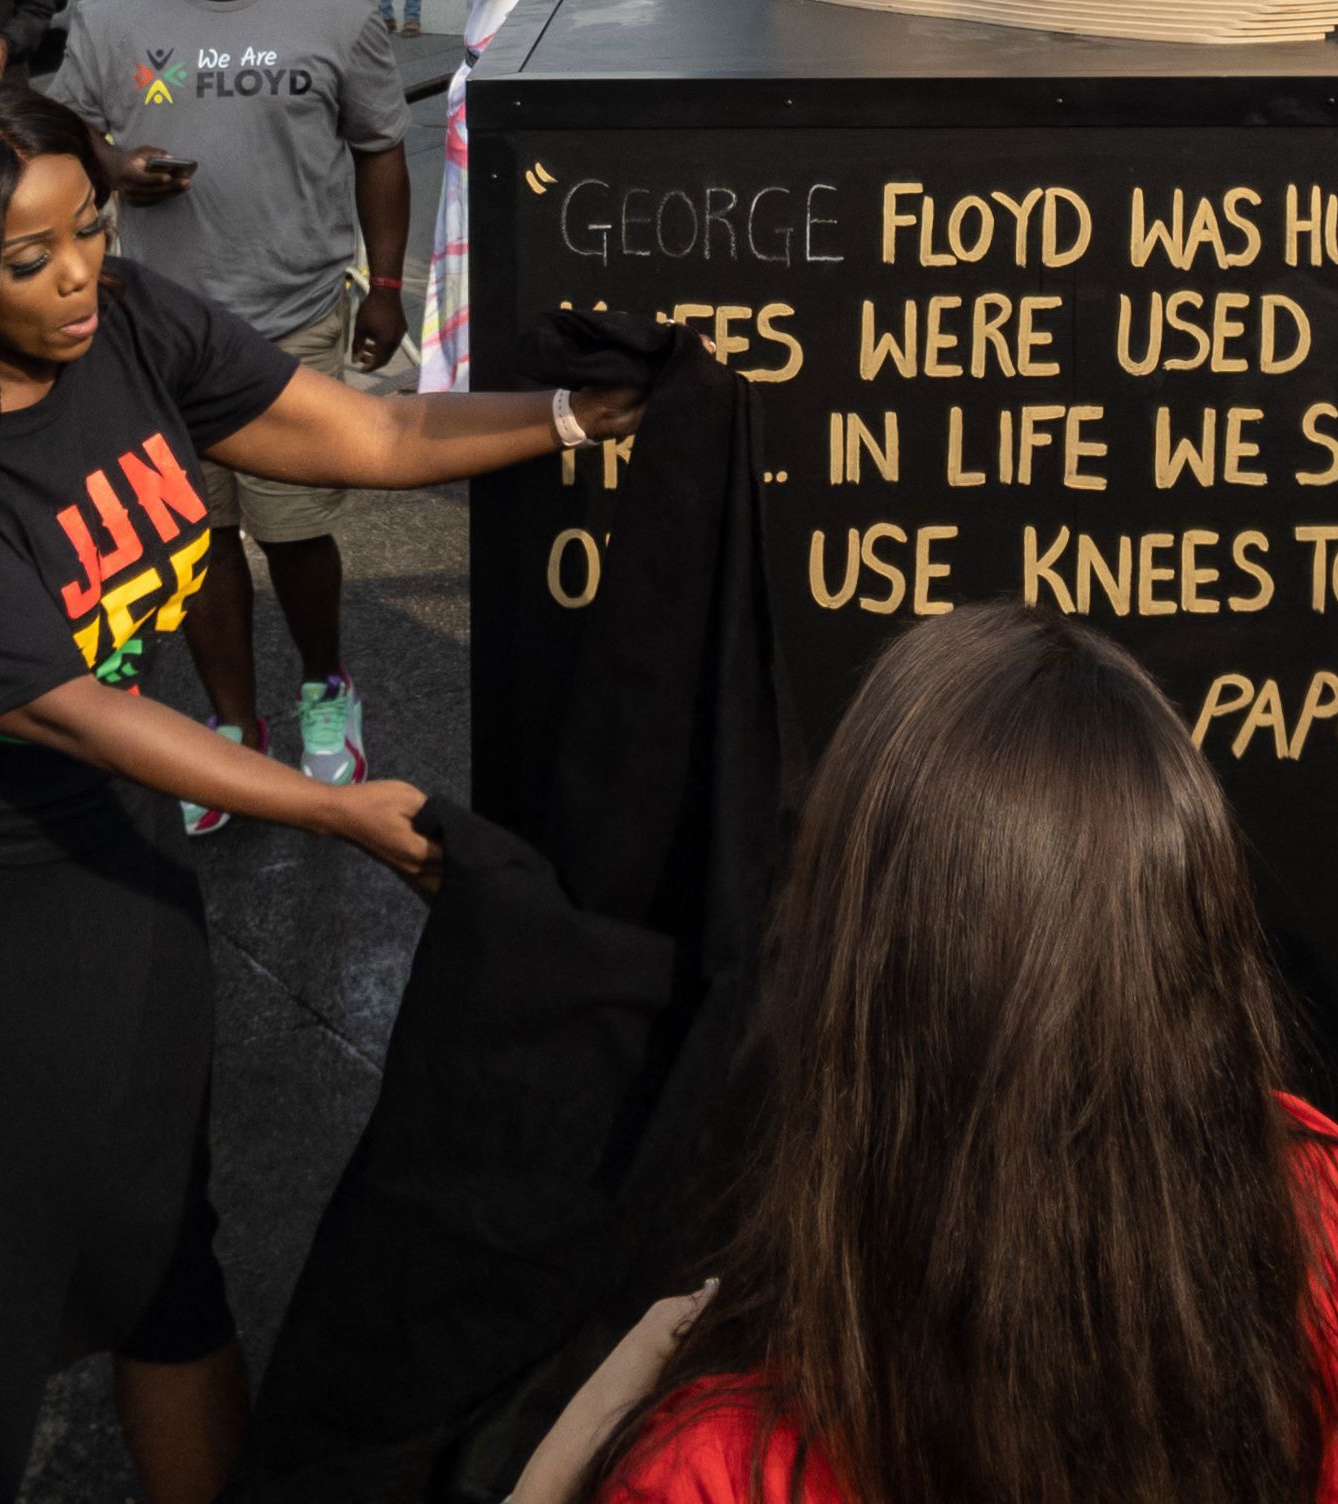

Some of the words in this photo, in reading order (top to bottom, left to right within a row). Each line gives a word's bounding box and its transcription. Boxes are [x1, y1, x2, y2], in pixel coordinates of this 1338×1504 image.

[196, 68, 312, 98] FLOYD
[198, 48, 231, 69] We
[241, 47, 278, 66] Are
[881, 182, 1092, 269] FLOYD
[1130, 186, 1261, 270] WAS
[860, 294, 1062, 380] WERE
[1116, 292, 1313, 376] USED
[829, 411, 901, 485] IN
[947, 404, 1109, 491] LIFE
[1153, 406, 1268, 490] WE
[809, 522, 960, 617] USE
[1022, 525, 1275, 617] KNEES
